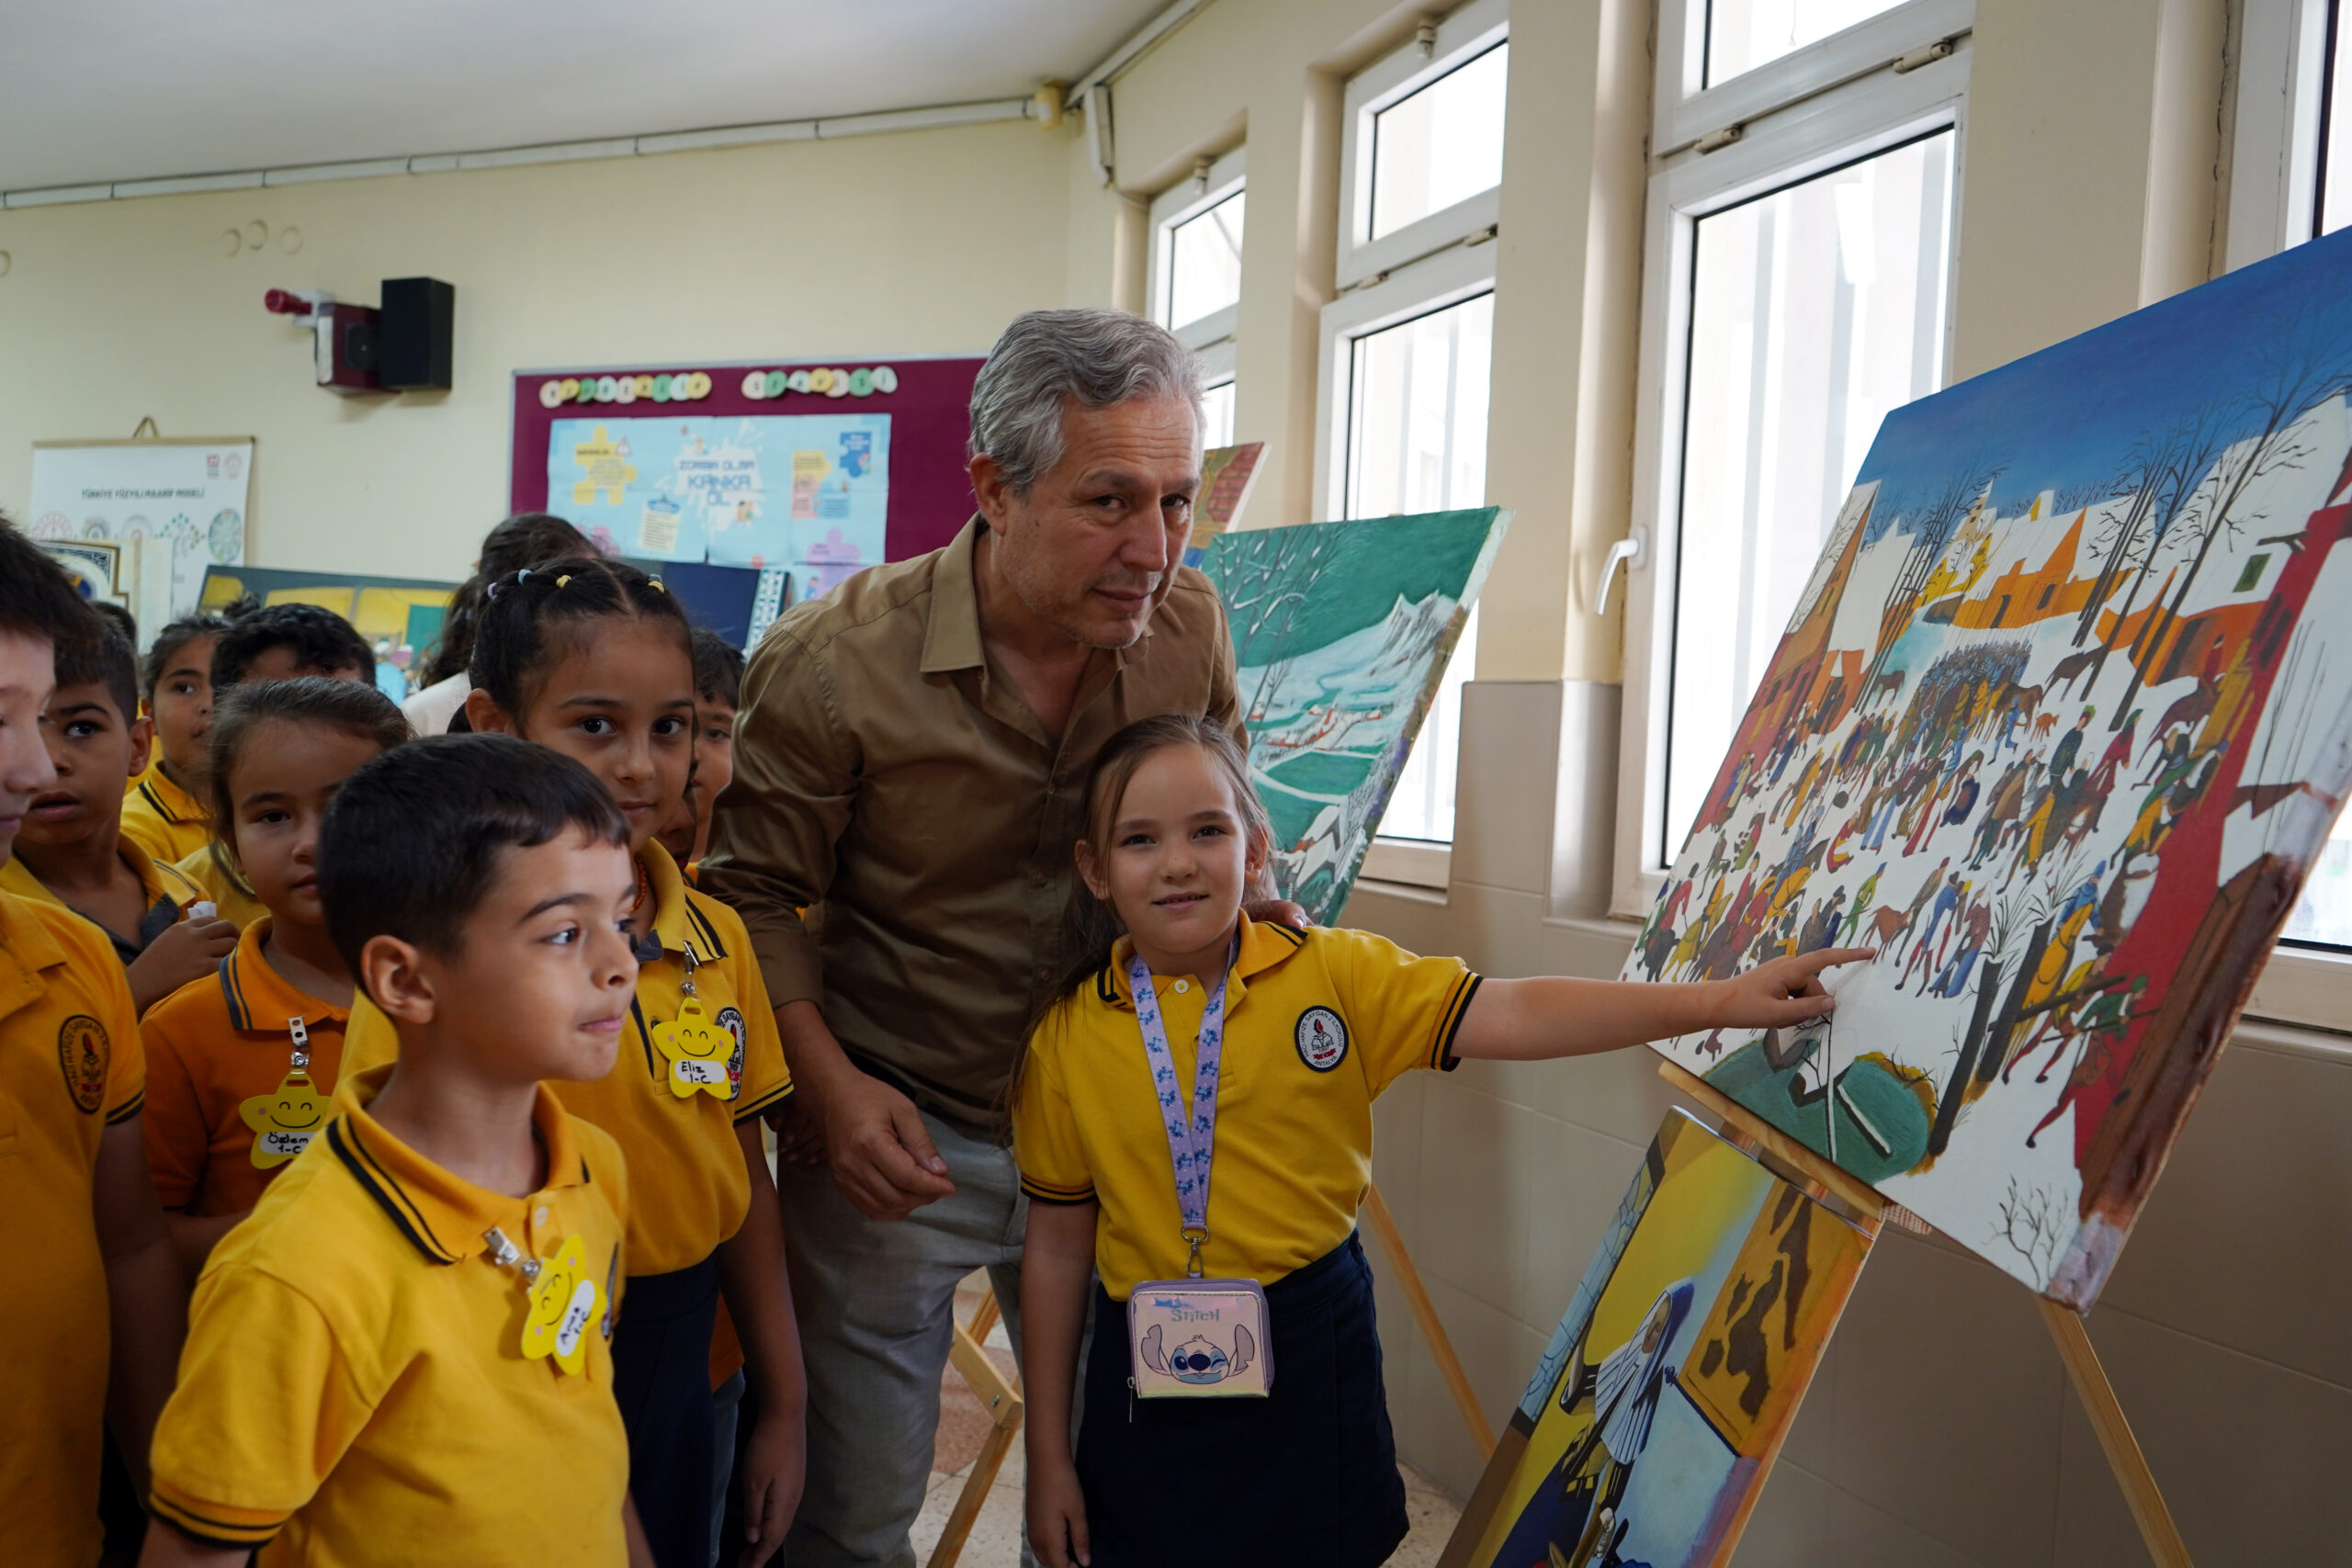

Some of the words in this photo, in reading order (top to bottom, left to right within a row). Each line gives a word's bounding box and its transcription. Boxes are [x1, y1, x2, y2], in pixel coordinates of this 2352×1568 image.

[688, 474, 752, 490] KANKA
[707, 491, 731, 505] OL
[1305, 1011, 1329, 1021] SAYGAN
[681, 1061, 705, 1073] Eliz
[1314, 1056, 1337, 1066] ANTALYA
